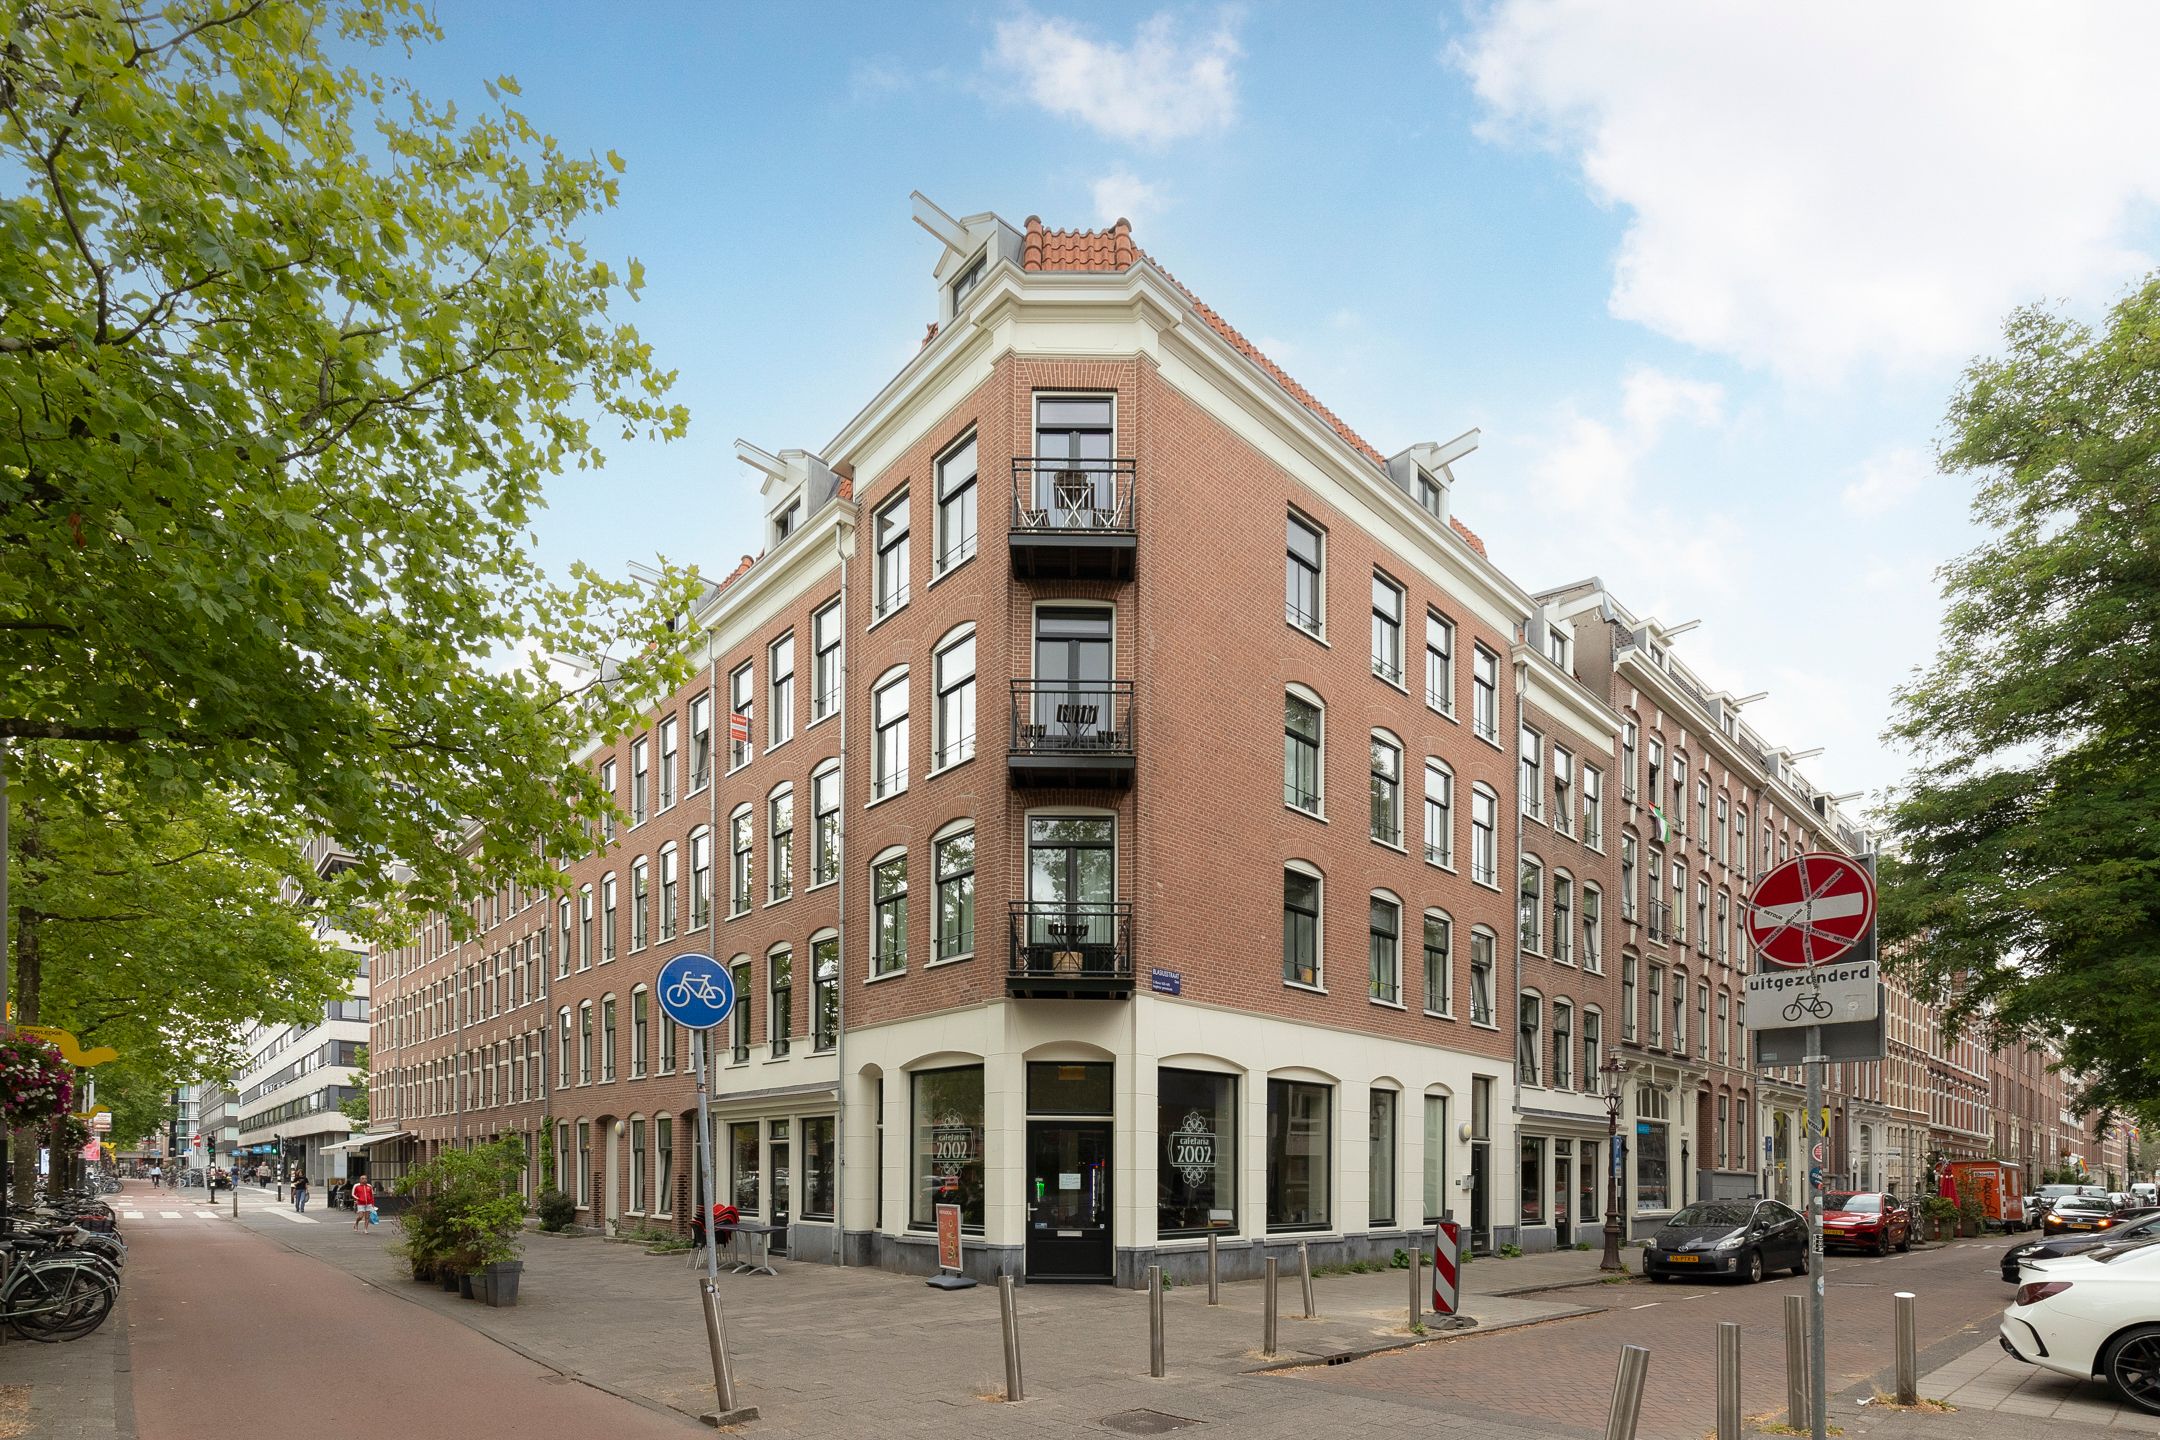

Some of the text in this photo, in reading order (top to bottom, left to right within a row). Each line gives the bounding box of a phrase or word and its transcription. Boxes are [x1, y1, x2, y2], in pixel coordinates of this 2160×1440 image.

[1763, 909, 1783, 920] RETOUR
[936, 1141, 967, 1159] 2002
[1177, 1145, 1211, 1163] 2002
